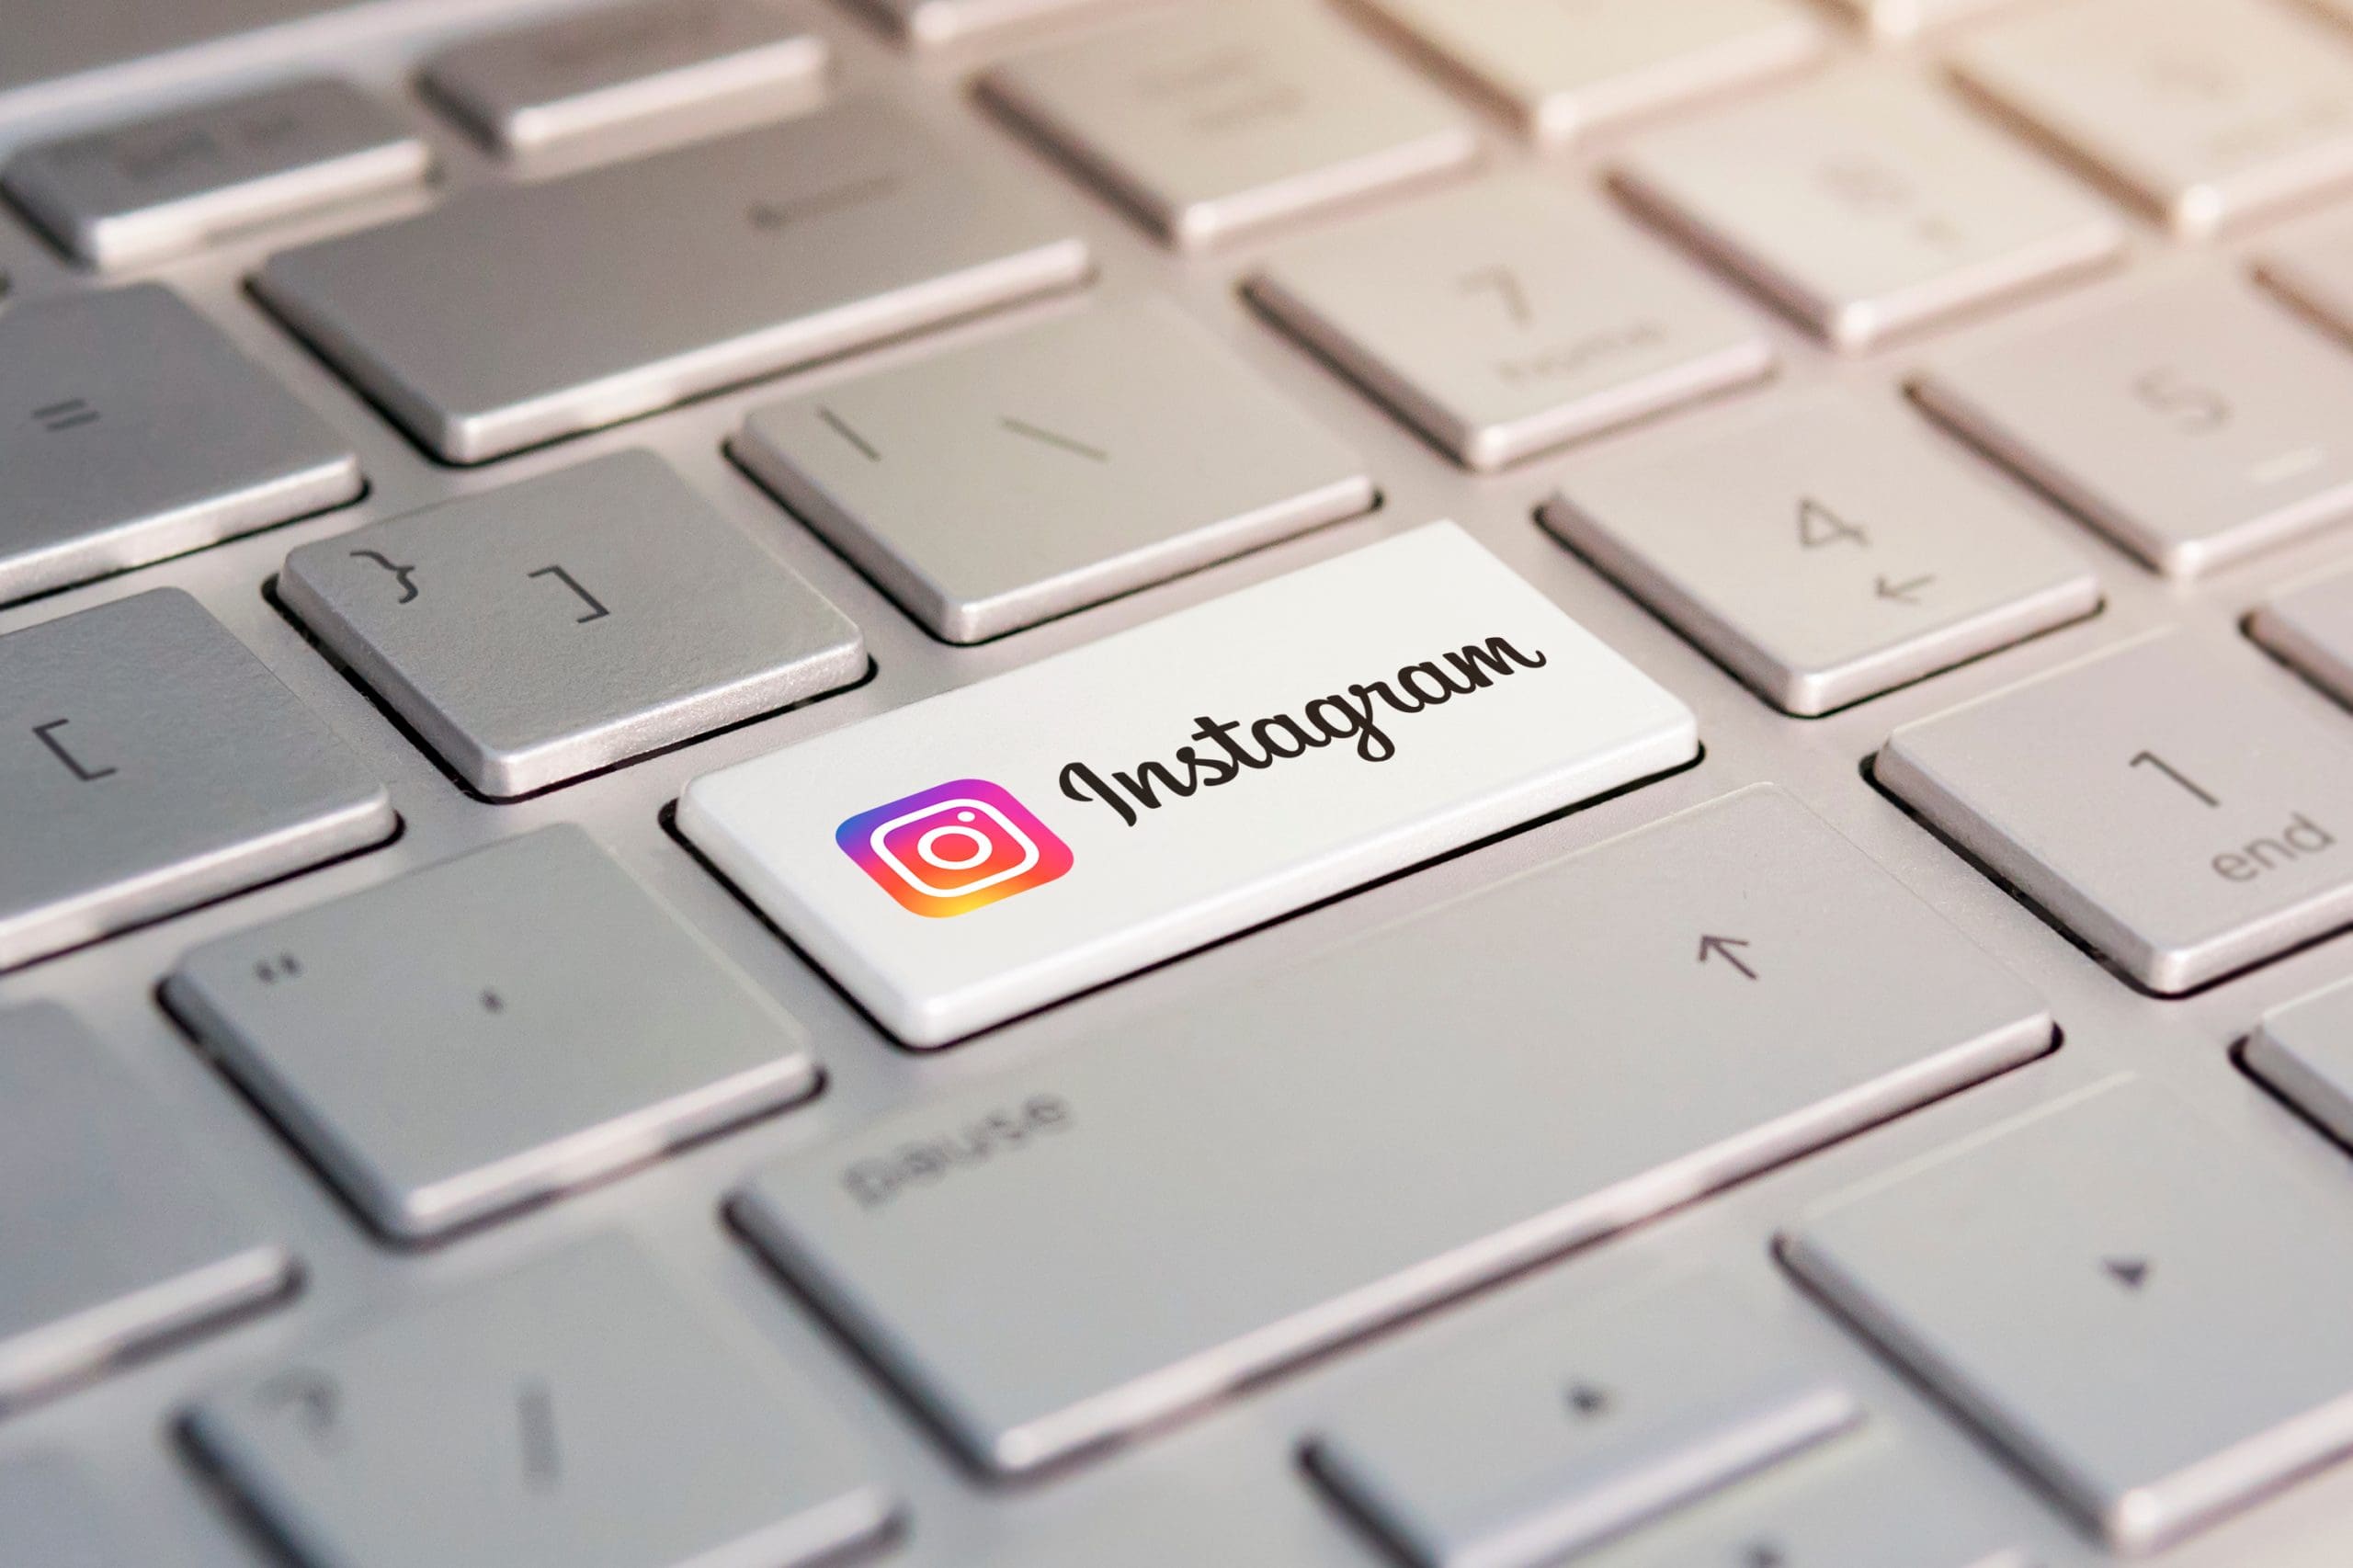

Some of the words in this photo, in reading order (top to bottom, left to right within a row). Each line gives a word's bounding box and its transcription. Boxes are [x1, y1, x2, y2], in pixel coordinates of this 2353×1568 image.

[1798, 496, 1870, 549] 4
[349, 550, 420, 604] }
[528, 564, 611, 624] ]
[31, 718, 118, 782] [
[1059, 636, 1547, 827] Instagram
[2129, 750, 2217, 808] 1
[2211, 812, 2336, 882] end
[844, 1094, 1070, 1210] pause
